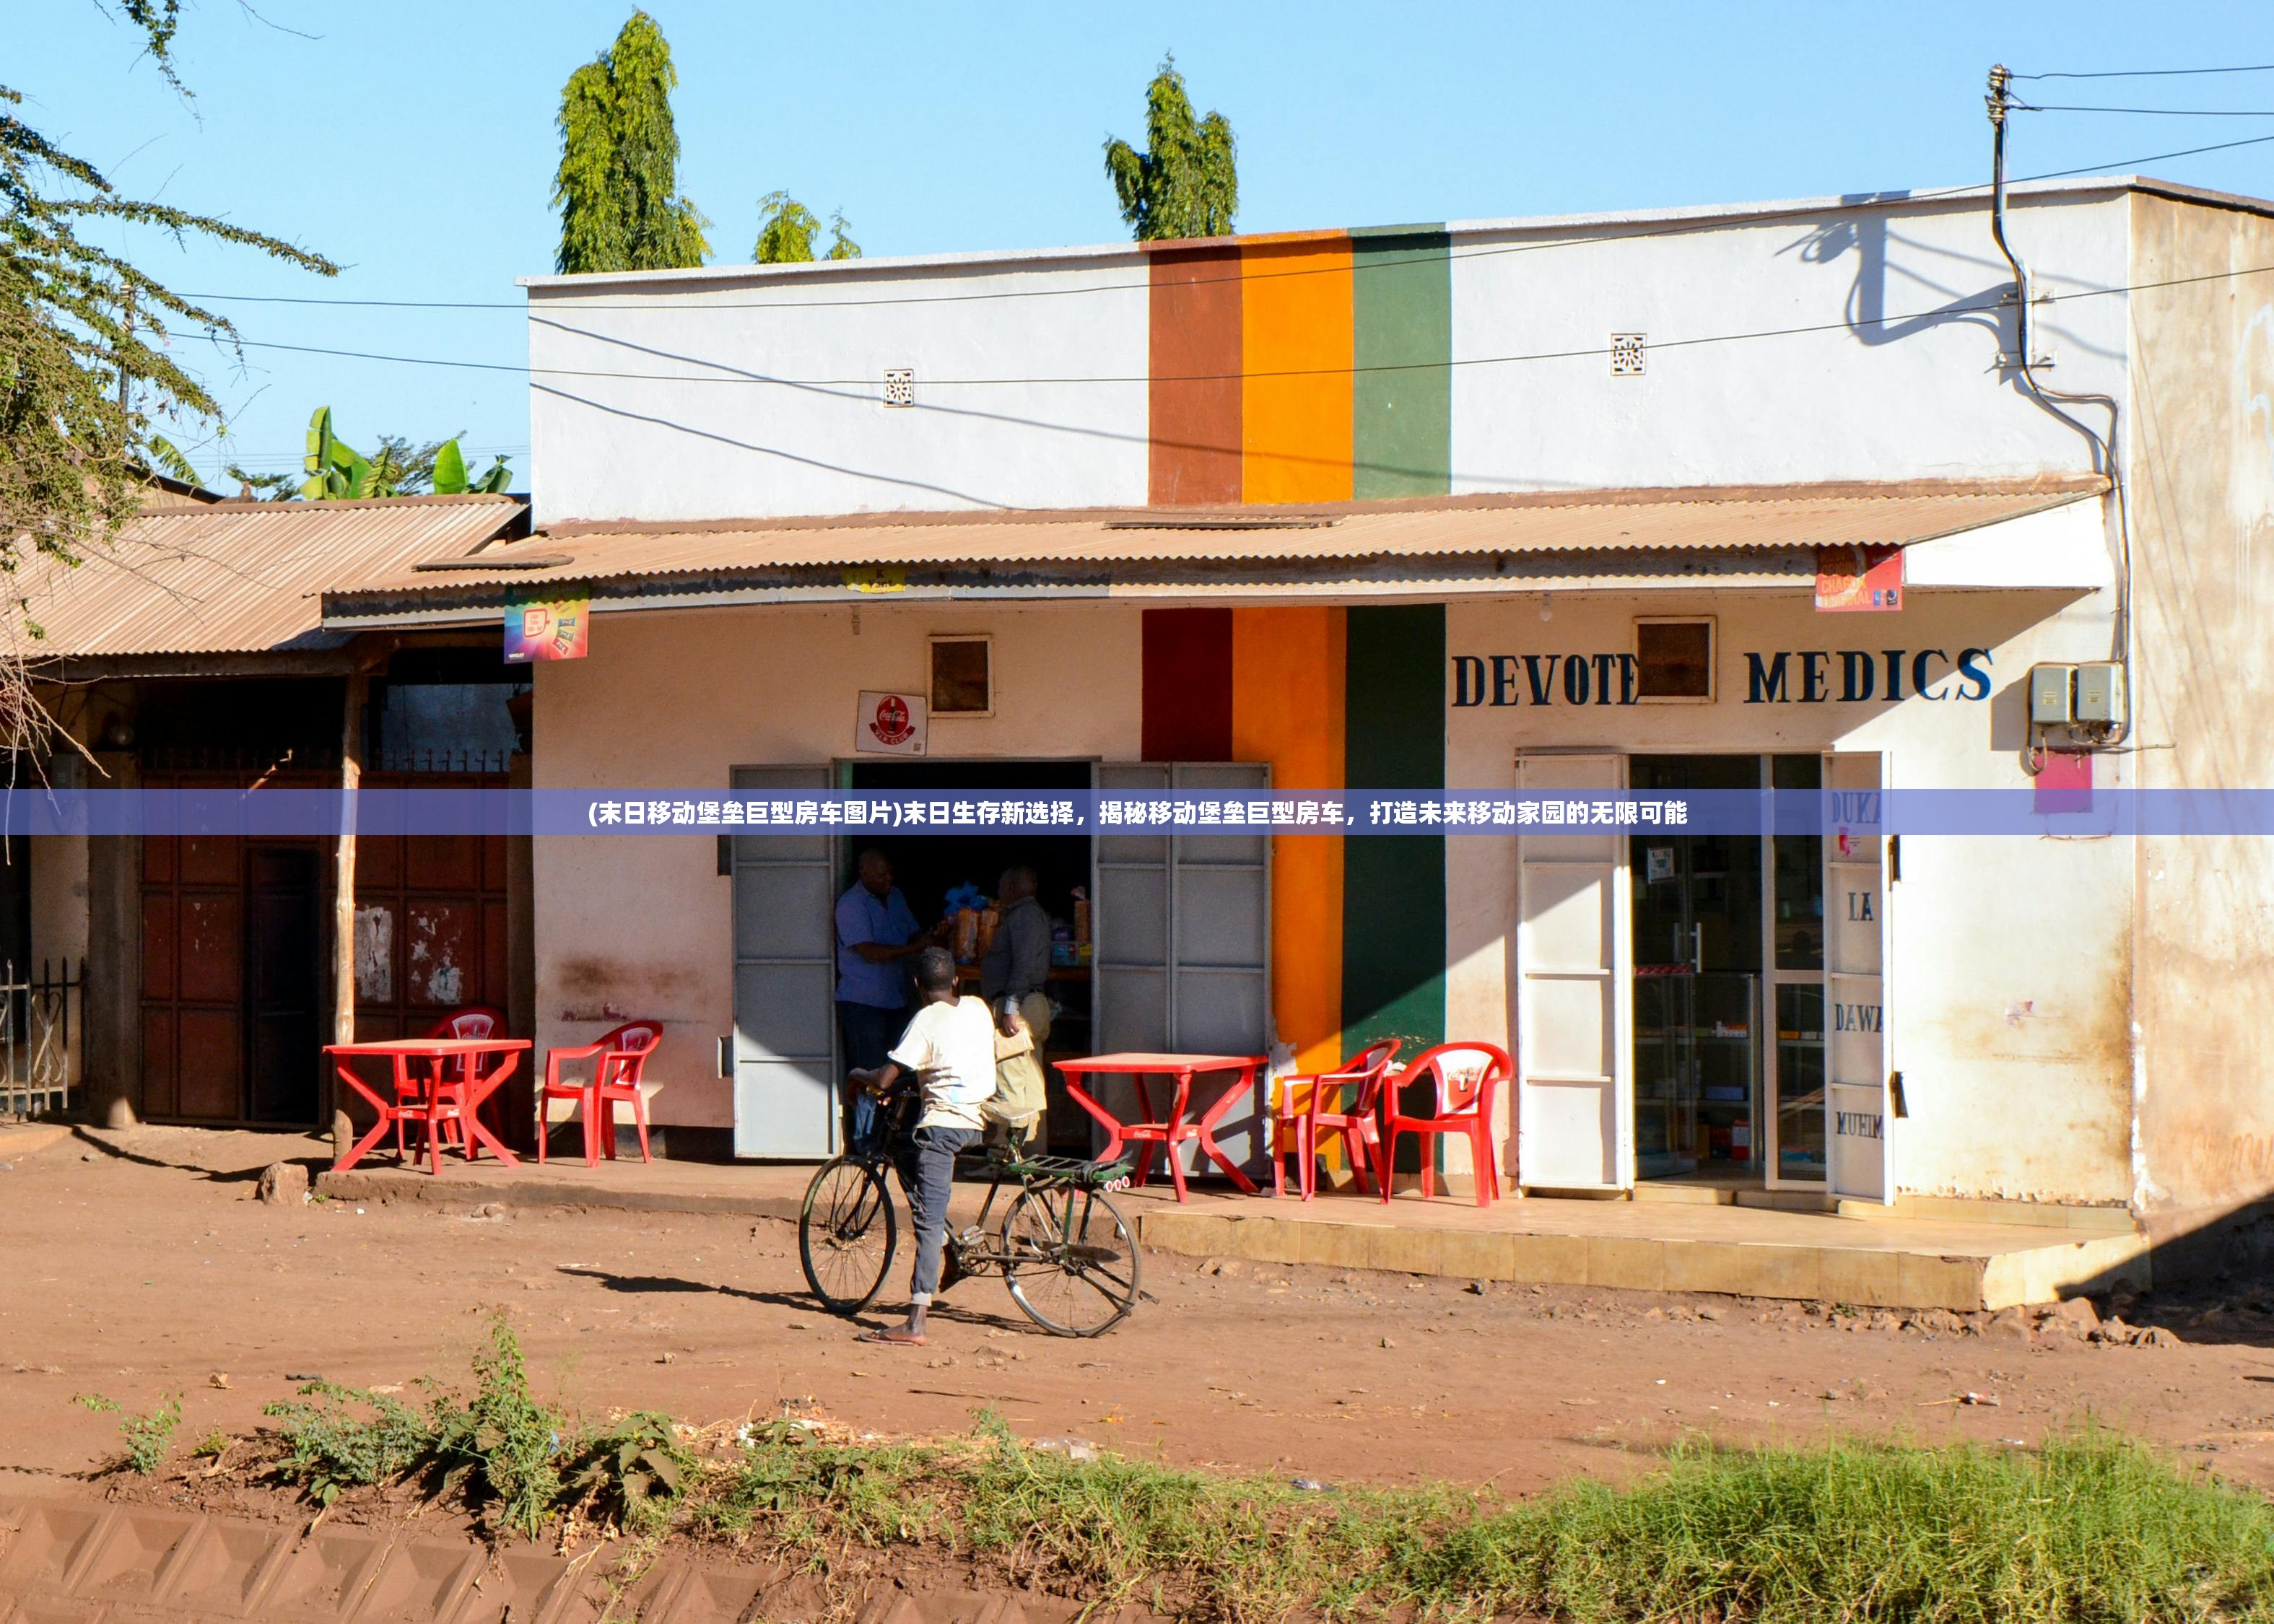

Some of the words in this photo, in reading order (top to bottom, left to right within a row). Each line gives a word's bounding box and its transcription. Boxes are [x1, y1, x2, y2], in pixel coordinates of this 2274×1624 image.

[1451, 653, 1639, 707] DEVOTE
[1743, 647, 1993, 703] MEDICS
[890, 732, 909, 745] CLUB
[1848, 892, 1873, 921] LA
